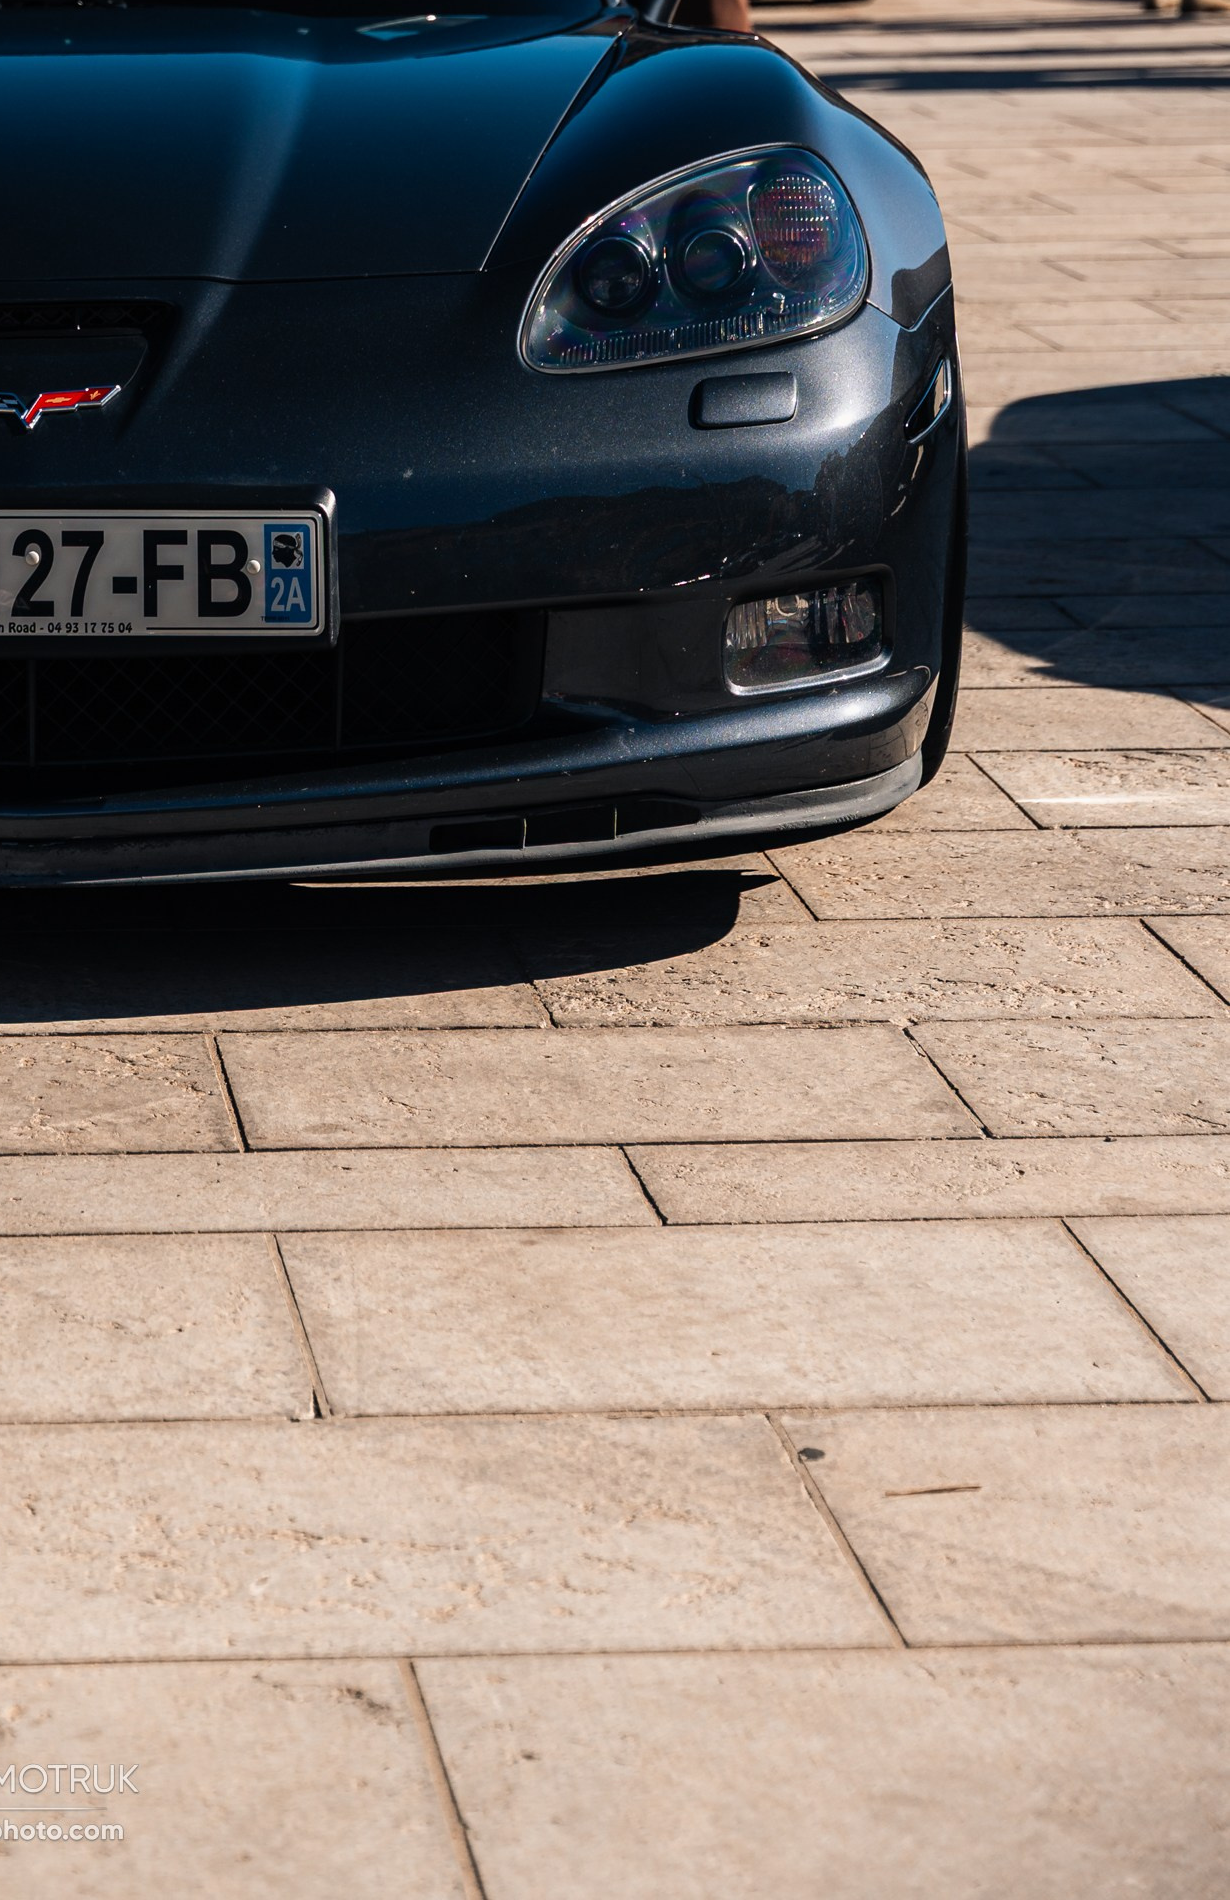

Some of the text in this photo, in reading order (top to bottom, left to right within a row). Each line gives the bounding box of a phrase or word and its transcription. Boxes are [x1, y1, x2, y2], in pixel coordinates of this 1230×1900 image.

[271, 576, 306, 612] 2A
[8, 622, 36, 633] Road
[47, 622, 62, 633] 04
[65, 622, 79, 633] 93
[83, 622, 97, 633] 17
[101, 622, 115, 633] 75
[118, 622, 132, 633] 04
